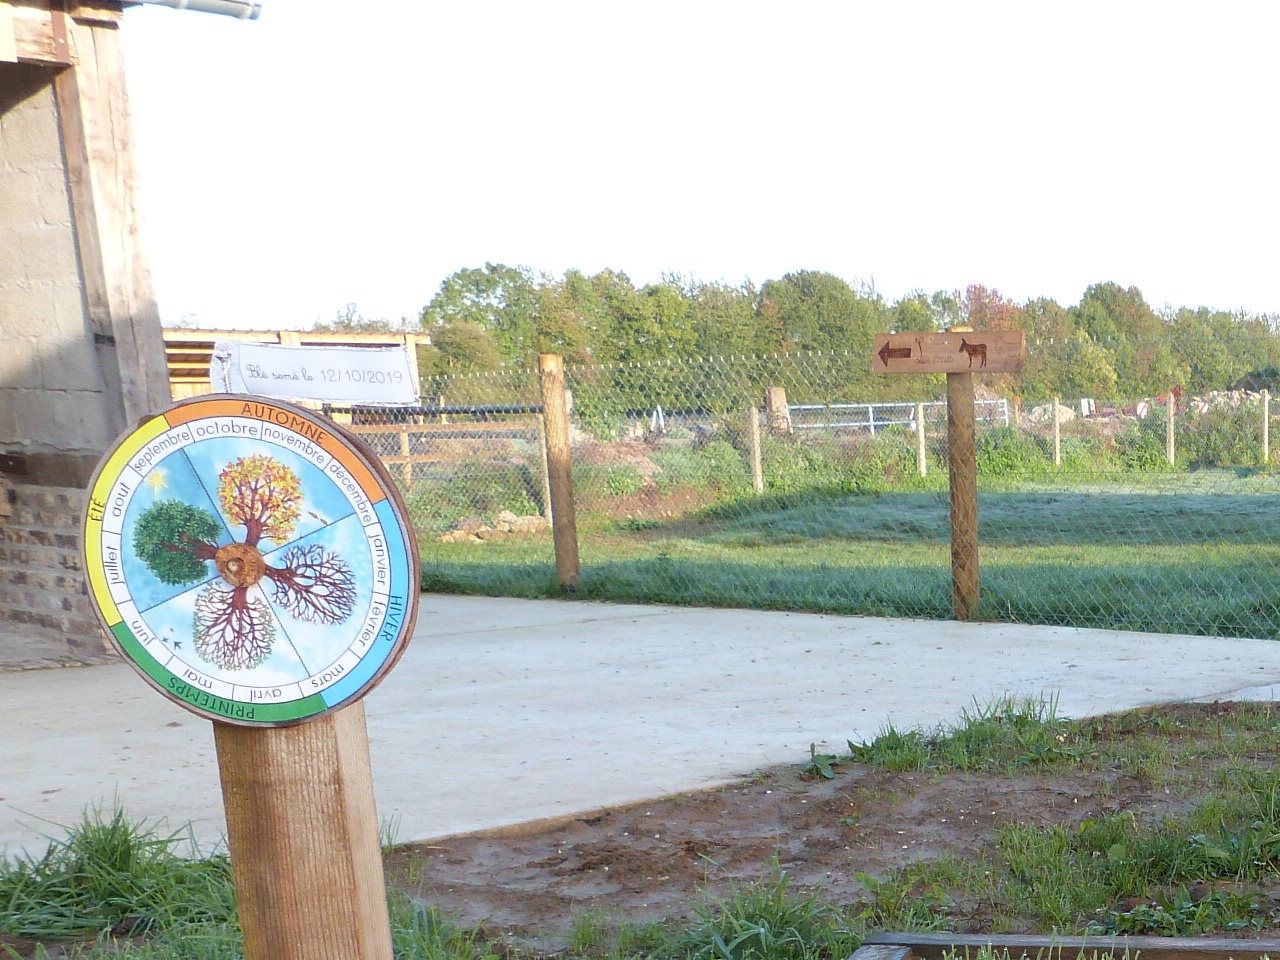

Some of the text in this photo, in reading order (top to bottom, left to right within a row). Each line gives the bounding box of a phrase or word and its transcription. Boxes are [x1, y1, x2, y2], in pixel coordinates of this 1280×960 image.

[320, 369, 404, 384] 12/10/2019
[196, 420, 258, 436] octobre
[241, 402, 327, 444] AUTOMNE
[134, 429, 191, 472] septembre
[264, 426, 325, 464] novembre
[113, 482, 131, 518] aout
[329, 458, 372, 524] décembre
[104, 545, 126, 585] juillet
[367, 533, 387, 586] janvier
[131, 619, 153, 647] juin
[358, 600, 382, 649] février
[380, 595, 403, 642] HIVER
[182, 669, 213, 690] mai
[250, 689, 282, 701] avril
[311, 663, 344, 688] mars
[167, 676, 255, 720] PRINTEMPS
